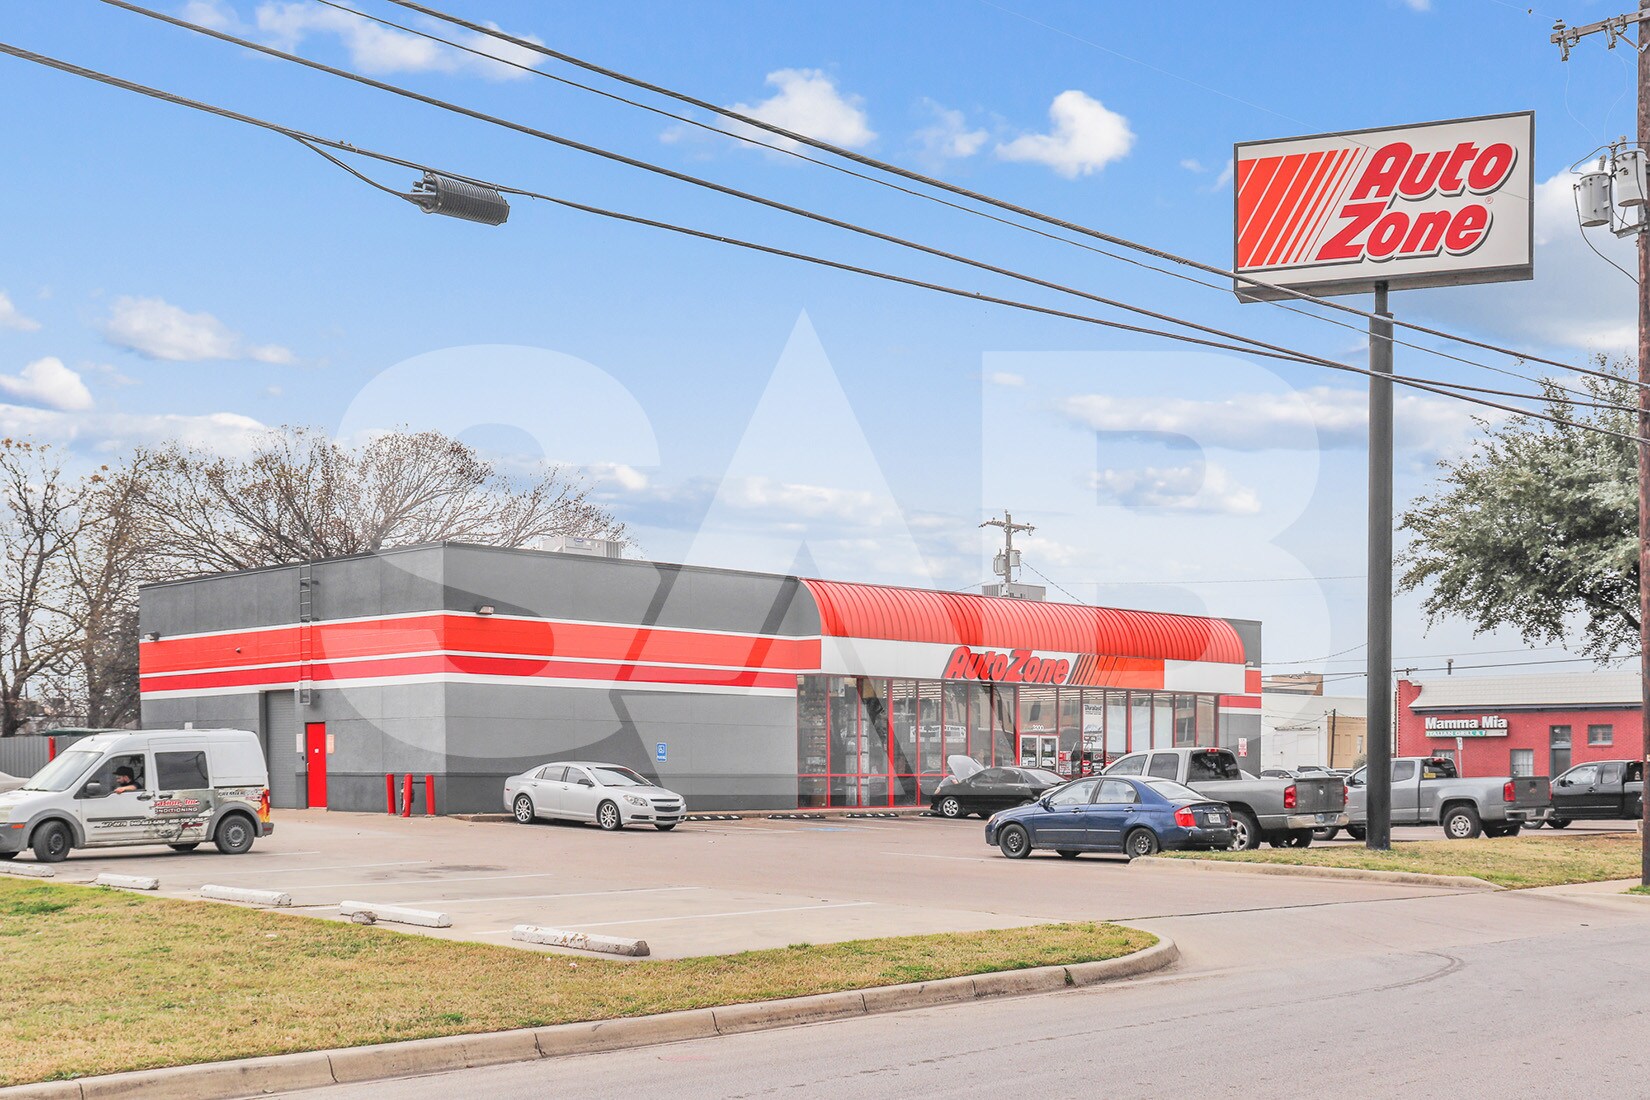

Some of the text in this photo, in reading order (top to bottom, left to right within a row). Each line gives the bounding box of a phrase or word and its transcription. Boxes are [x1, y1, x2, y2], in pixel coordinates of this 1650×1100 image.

[1349, 141, 1516, 201] Auto
[1314, 201, 1491, 261] Zone
[943, 645, 1070, 685] AutoZone
[1425, 715, 1508, 730] Mamma Mia
